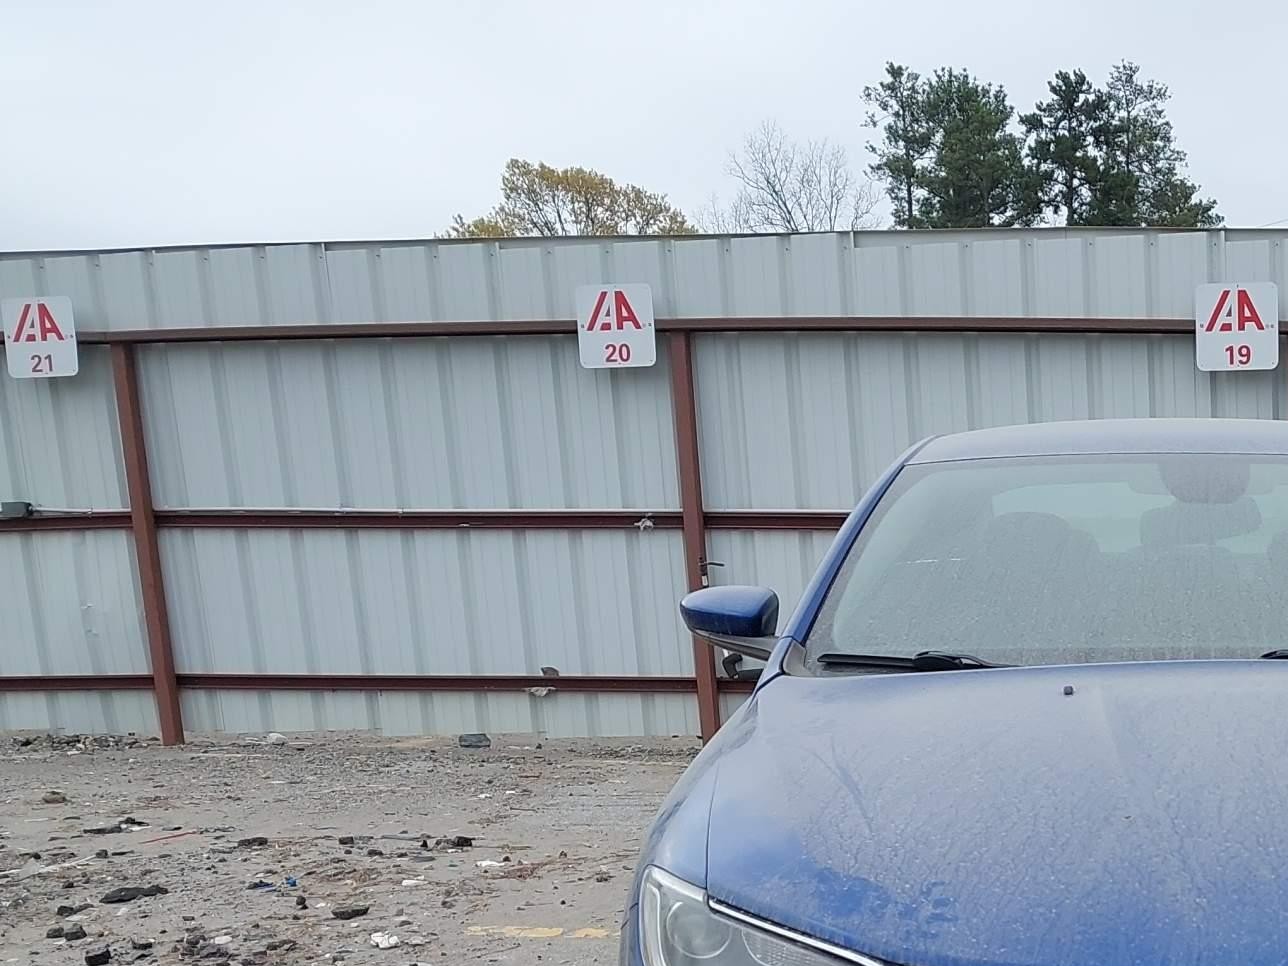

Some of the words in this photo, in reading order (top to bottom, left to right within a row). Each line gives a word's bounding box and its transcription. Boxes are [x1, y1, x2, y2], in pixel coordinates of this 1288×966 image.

[605, 343, 631, 362] 20
[1225, 345, 1251, 365] 19
[31, 354, 53, 373] 21
